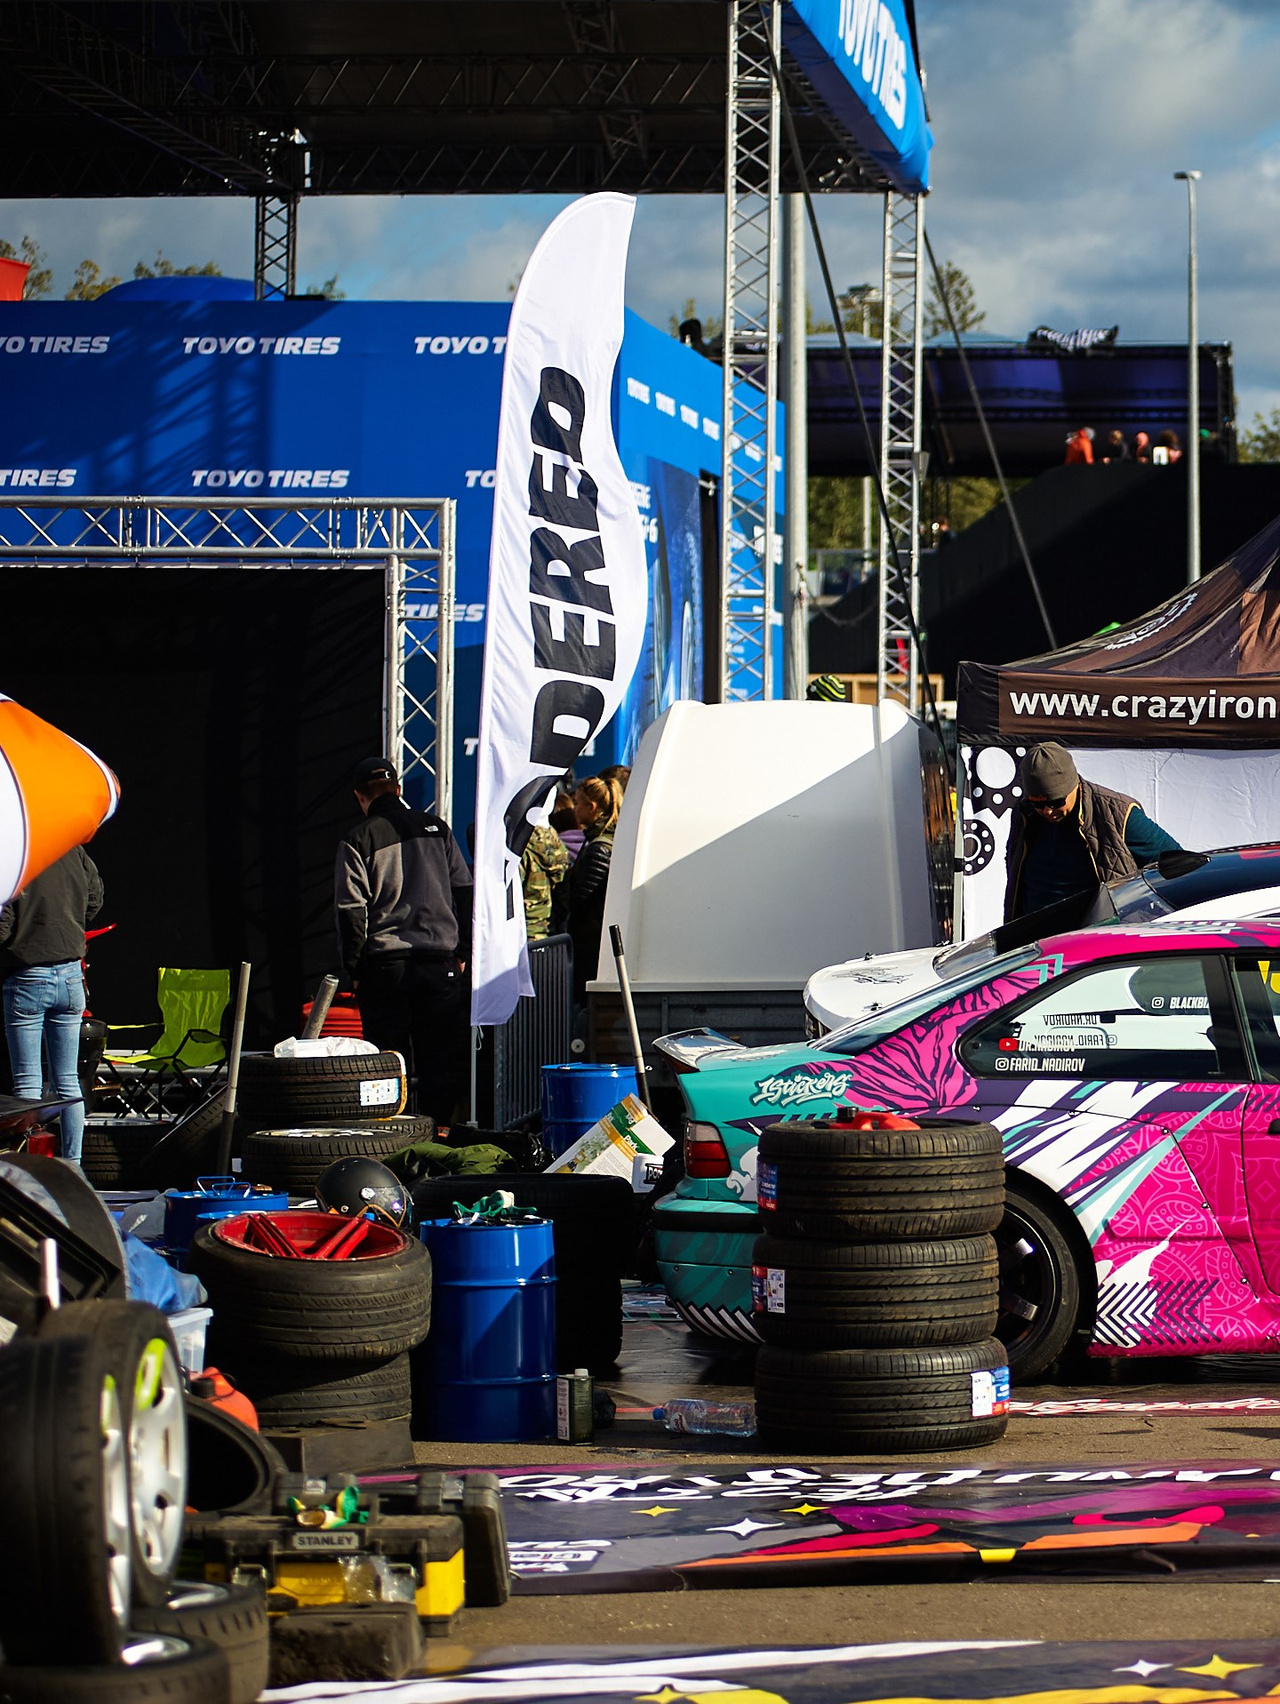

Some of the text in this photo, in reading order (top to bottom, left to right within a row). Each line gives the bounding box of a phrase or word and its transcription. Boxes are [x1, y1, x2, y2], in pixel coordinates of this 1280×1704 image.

[29, 336, 110, 353] TIRES
[183, 336, 342, 355] TOYO TIRES
[414, 336, 489, 355] TOYO
[0, 469, 77, 487] TIRES
[191, 469, 350, 488] TOYO TIRES
[1009, 1057, 1086, 1072] FARID_NADIROV
[298, 1535, 353, 1546] STANLEY
